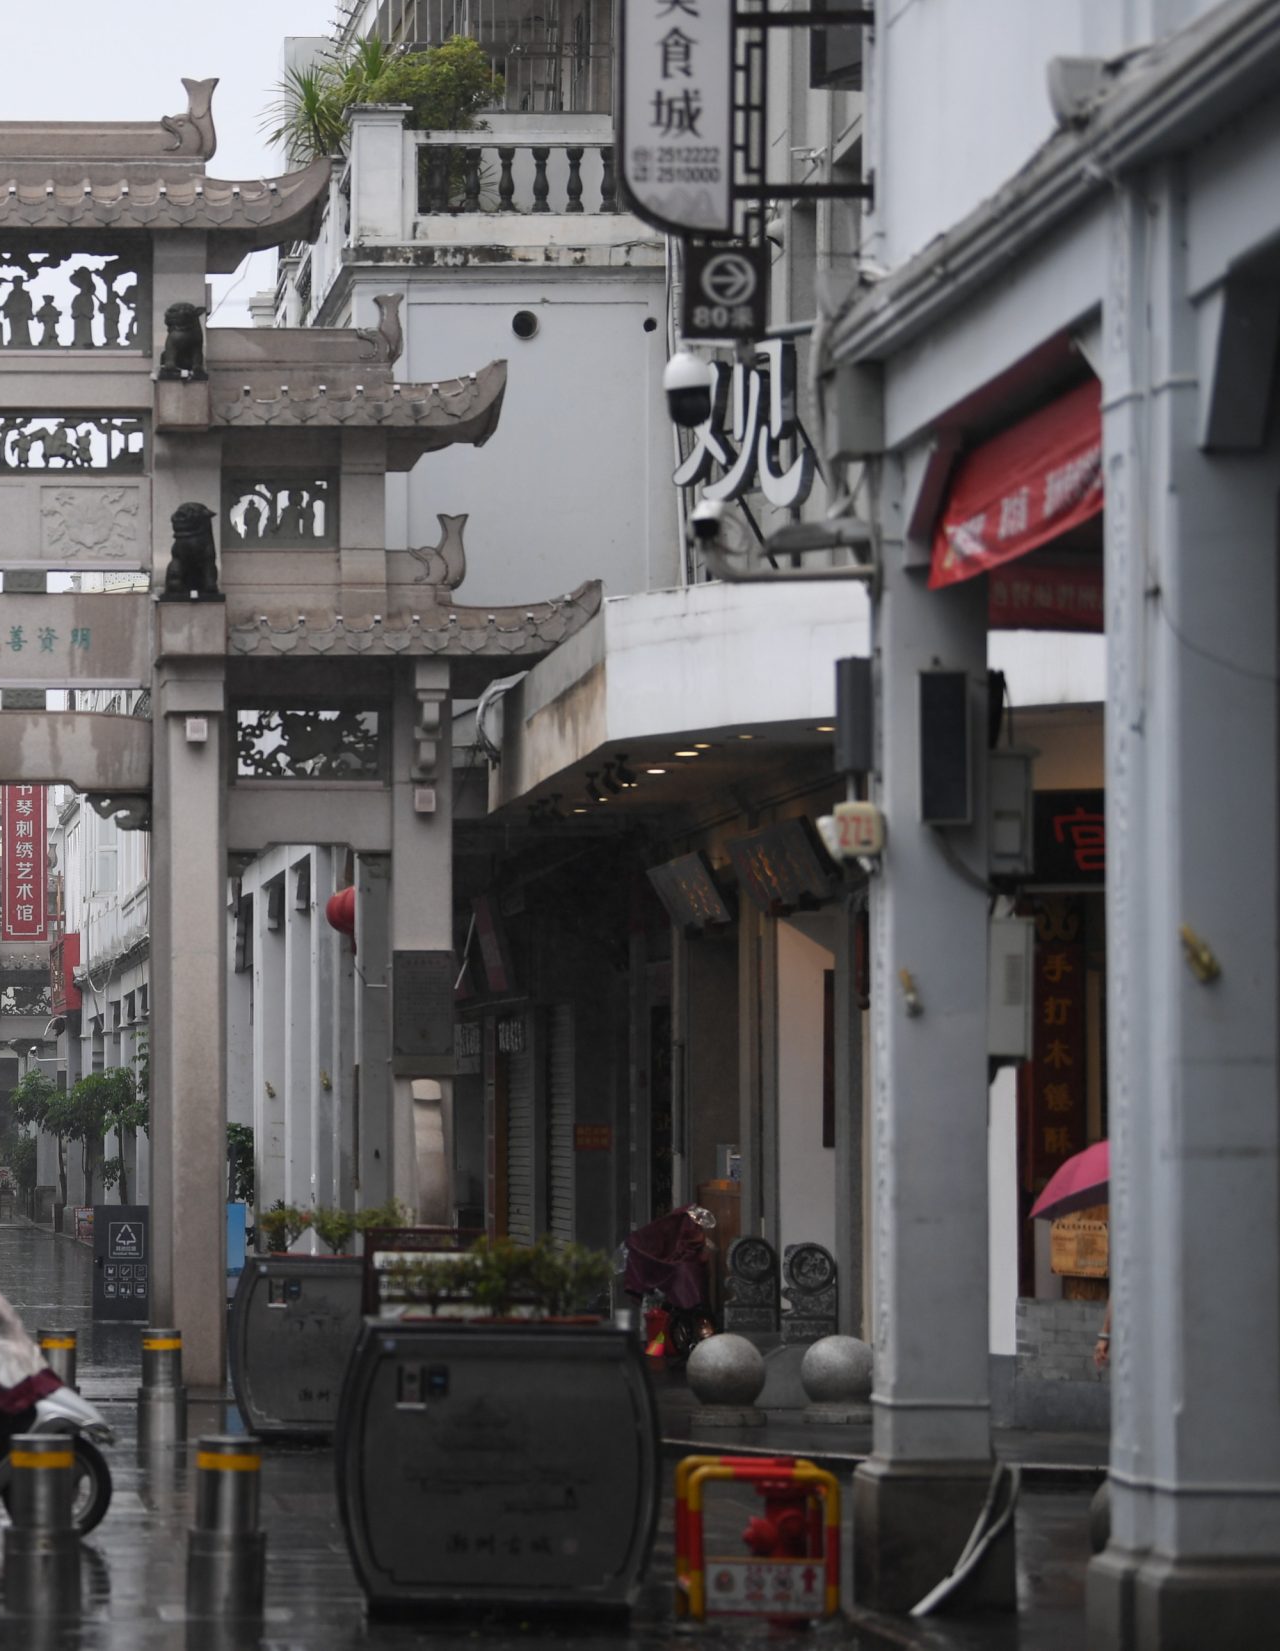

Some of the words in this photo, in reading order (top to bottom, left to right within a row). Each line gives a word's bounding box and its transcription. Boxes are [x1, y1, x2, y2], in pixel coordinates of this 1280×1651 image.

[657, 147, 720, 163] 2512222
[657, 167, 721, 184] 2510000
[673, 339, 808, 506] 观
